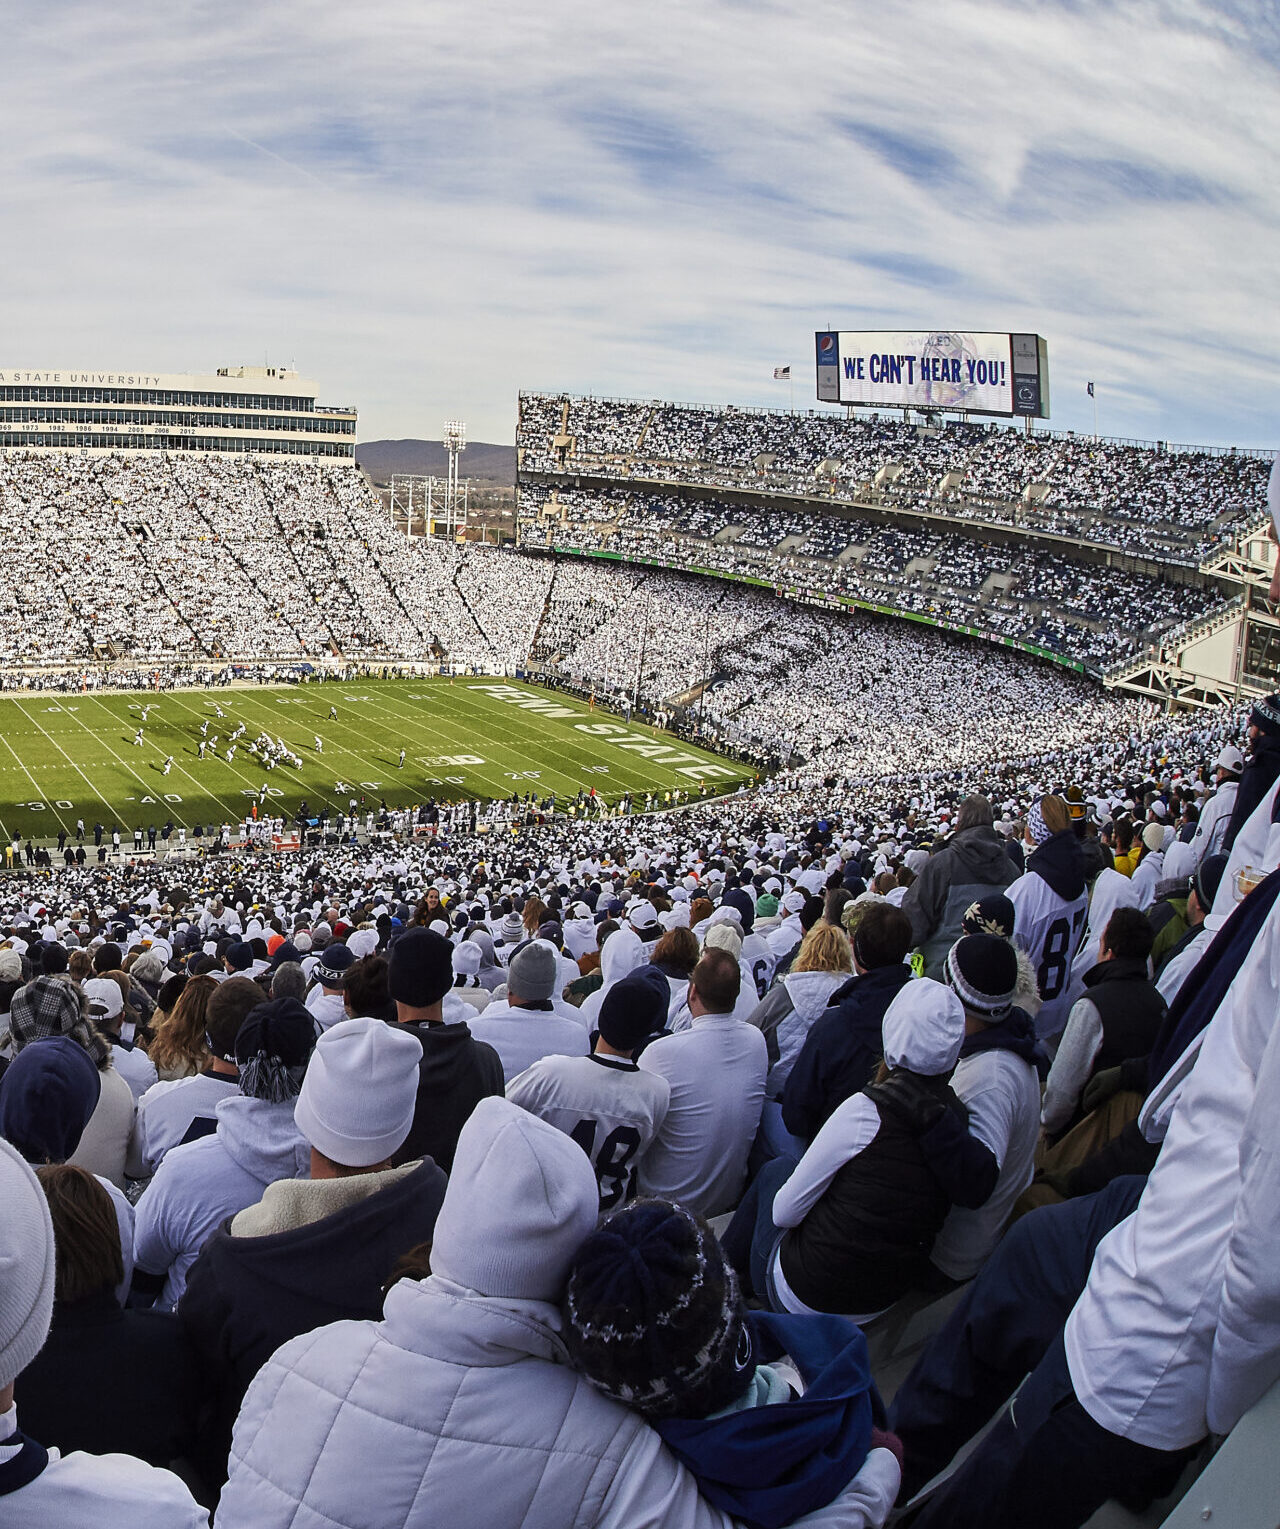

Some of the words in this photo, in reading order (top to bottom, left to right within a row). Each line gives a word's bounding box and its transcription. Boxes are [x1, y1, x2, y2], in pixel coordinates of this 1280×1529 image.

[14, 373, 61, 382] STATE
[70, 374, 160, 386] UNIVERSITY
[844, 357, 865, 380] WE
[870, 354, 917, 385] CAN'T
[921, 357, 961, 383] HEAR
[967, 359, 1006, 386] YOU!
[467, 684, 588, 719] PENN
[574, 724, 736, 779] STATE
[320, 967, 345, 979] STAT
